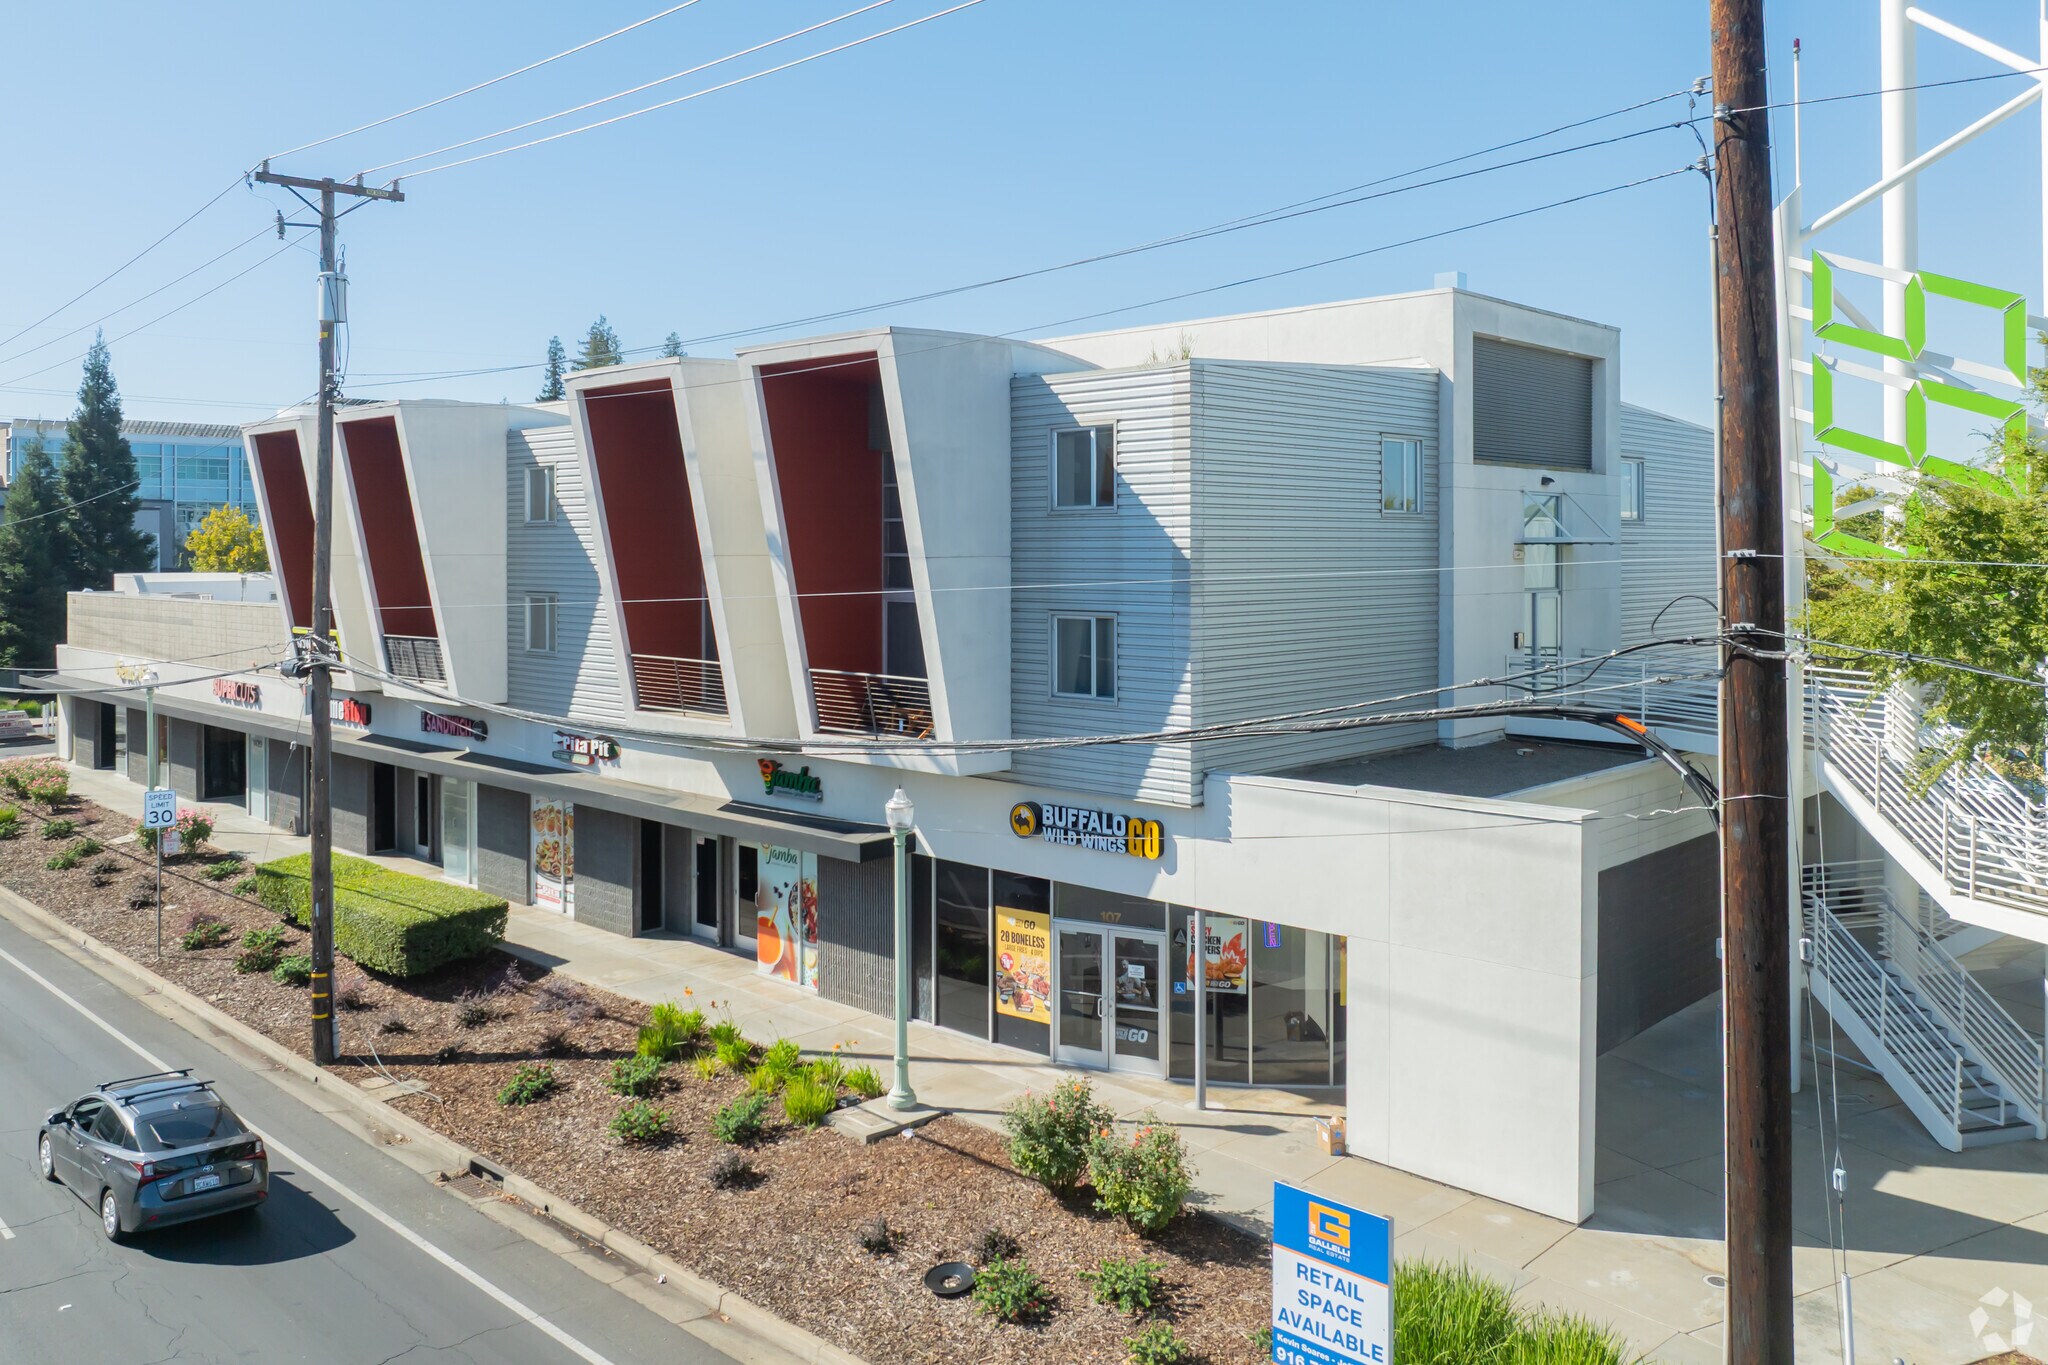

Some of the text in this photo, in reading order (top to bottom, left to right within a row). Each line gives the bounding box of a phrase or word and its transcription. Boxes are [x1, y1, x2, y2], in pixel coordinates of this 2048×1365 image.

[213, 678, 257, 703] SUPERCUTS
[426, 713, 472, 737] SANDWICH
[563, 735, 610, 757] Pita Pit
[148, 793, 173, 801] SPEED
[148, 810, 173, 824] 30
[1042, 804, 1126, 837] BUFFALO
[1042, 826, 1126, 854] WILD WINGS
[1128, 817, 1160, 860] GO
[1024, 919, 1036, 930] GO
[1100, 911, 1121, 923] 107
[1011, 932, 1045, 949] BONELESS
[1128, 1028, 1149, 1043] GO
[1308, 1236, 1350, 1257] GALLELLI
[1308, 1244, 1350, 1263] REAL ESTATE
[1297, 1262, 1364, 1302] RETAIL
[1298, 1289, 1362, 1328] SPACE
[1278, 1307, 1383, 1363] AVAILABLE
[1276, 1334, 1299, 1349] Kevin
[1301, 1343, 1330, 1362] Soares
